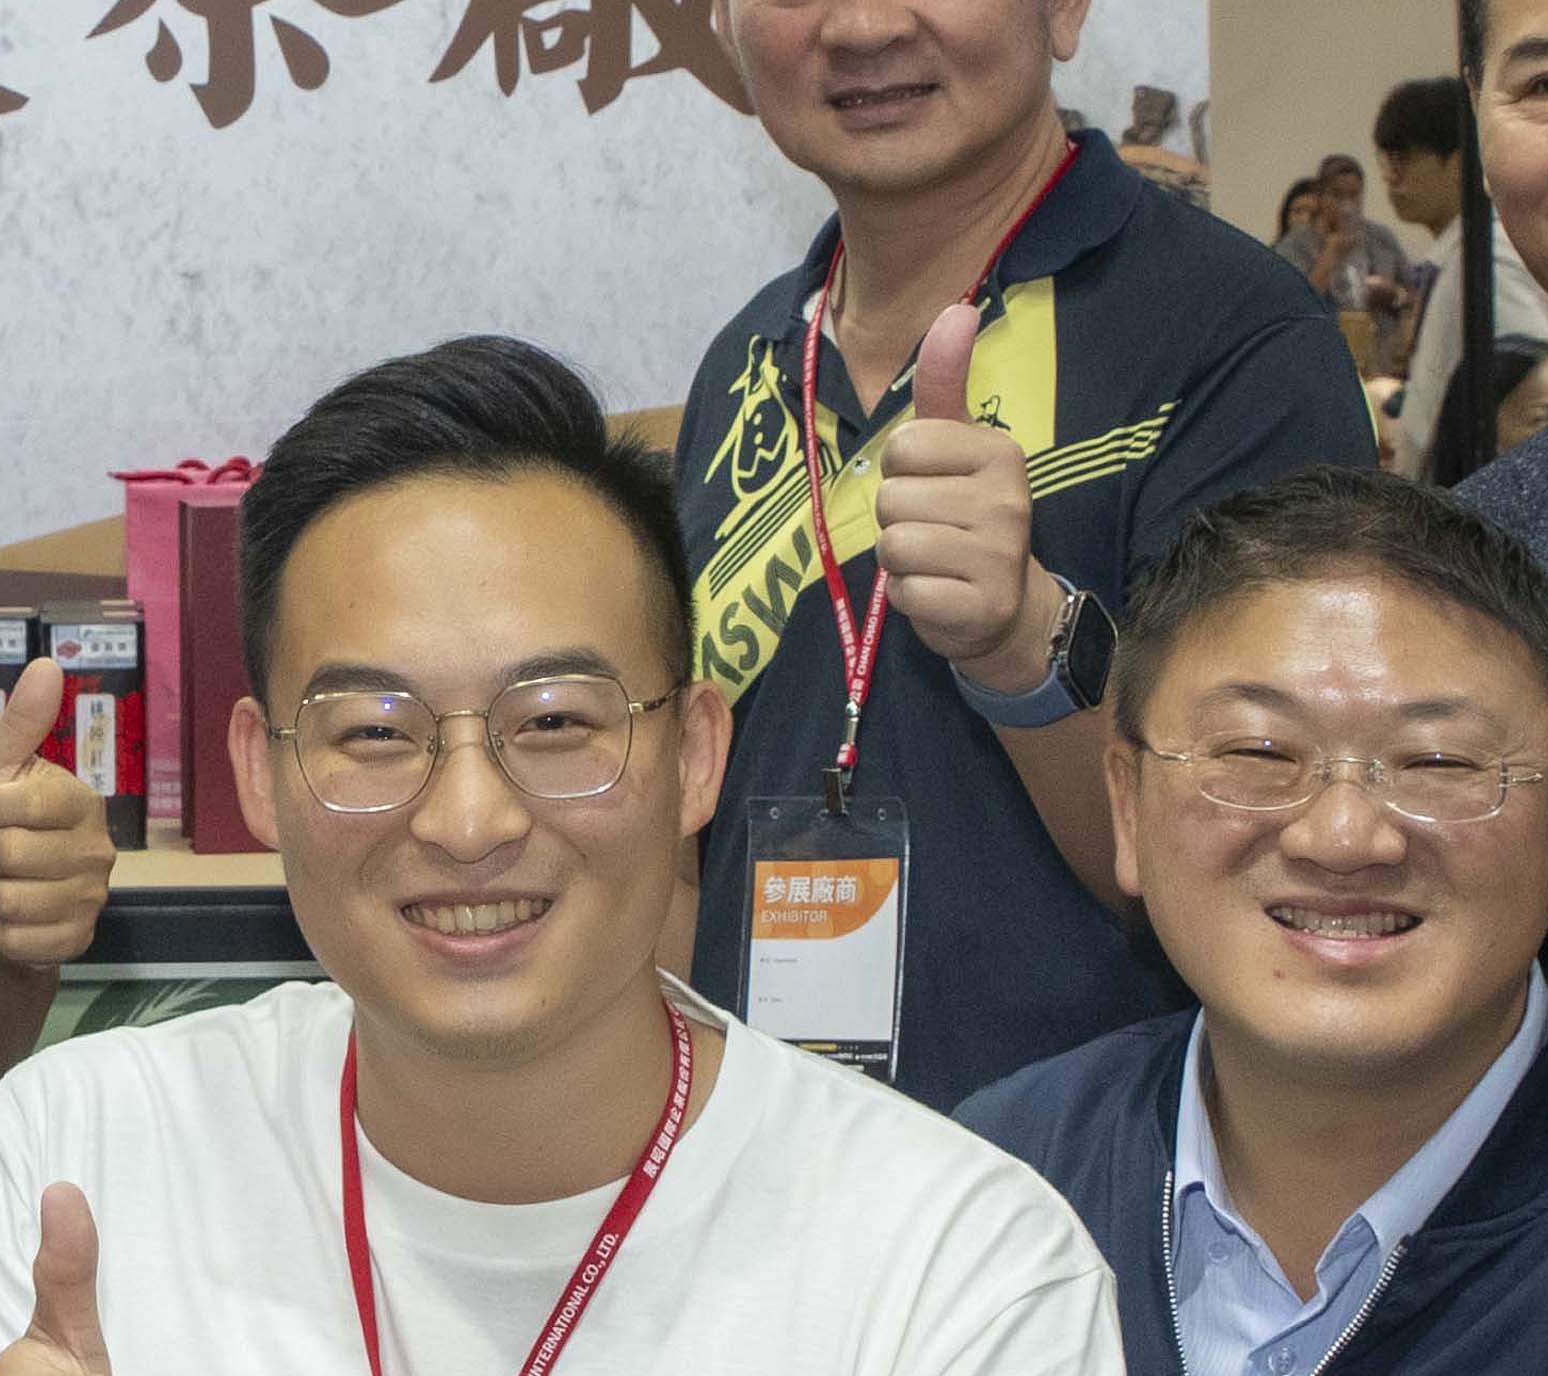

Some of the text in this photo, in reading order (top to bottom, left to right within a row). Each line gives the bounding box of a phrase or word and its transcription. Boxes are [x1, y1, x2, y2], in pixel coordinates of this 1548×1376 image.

[763, 875, 858, 904] 參展廠商
[760, 910, 828, 924] EXHIBITOR
[594, 1228, 620, 1259] LTD.
